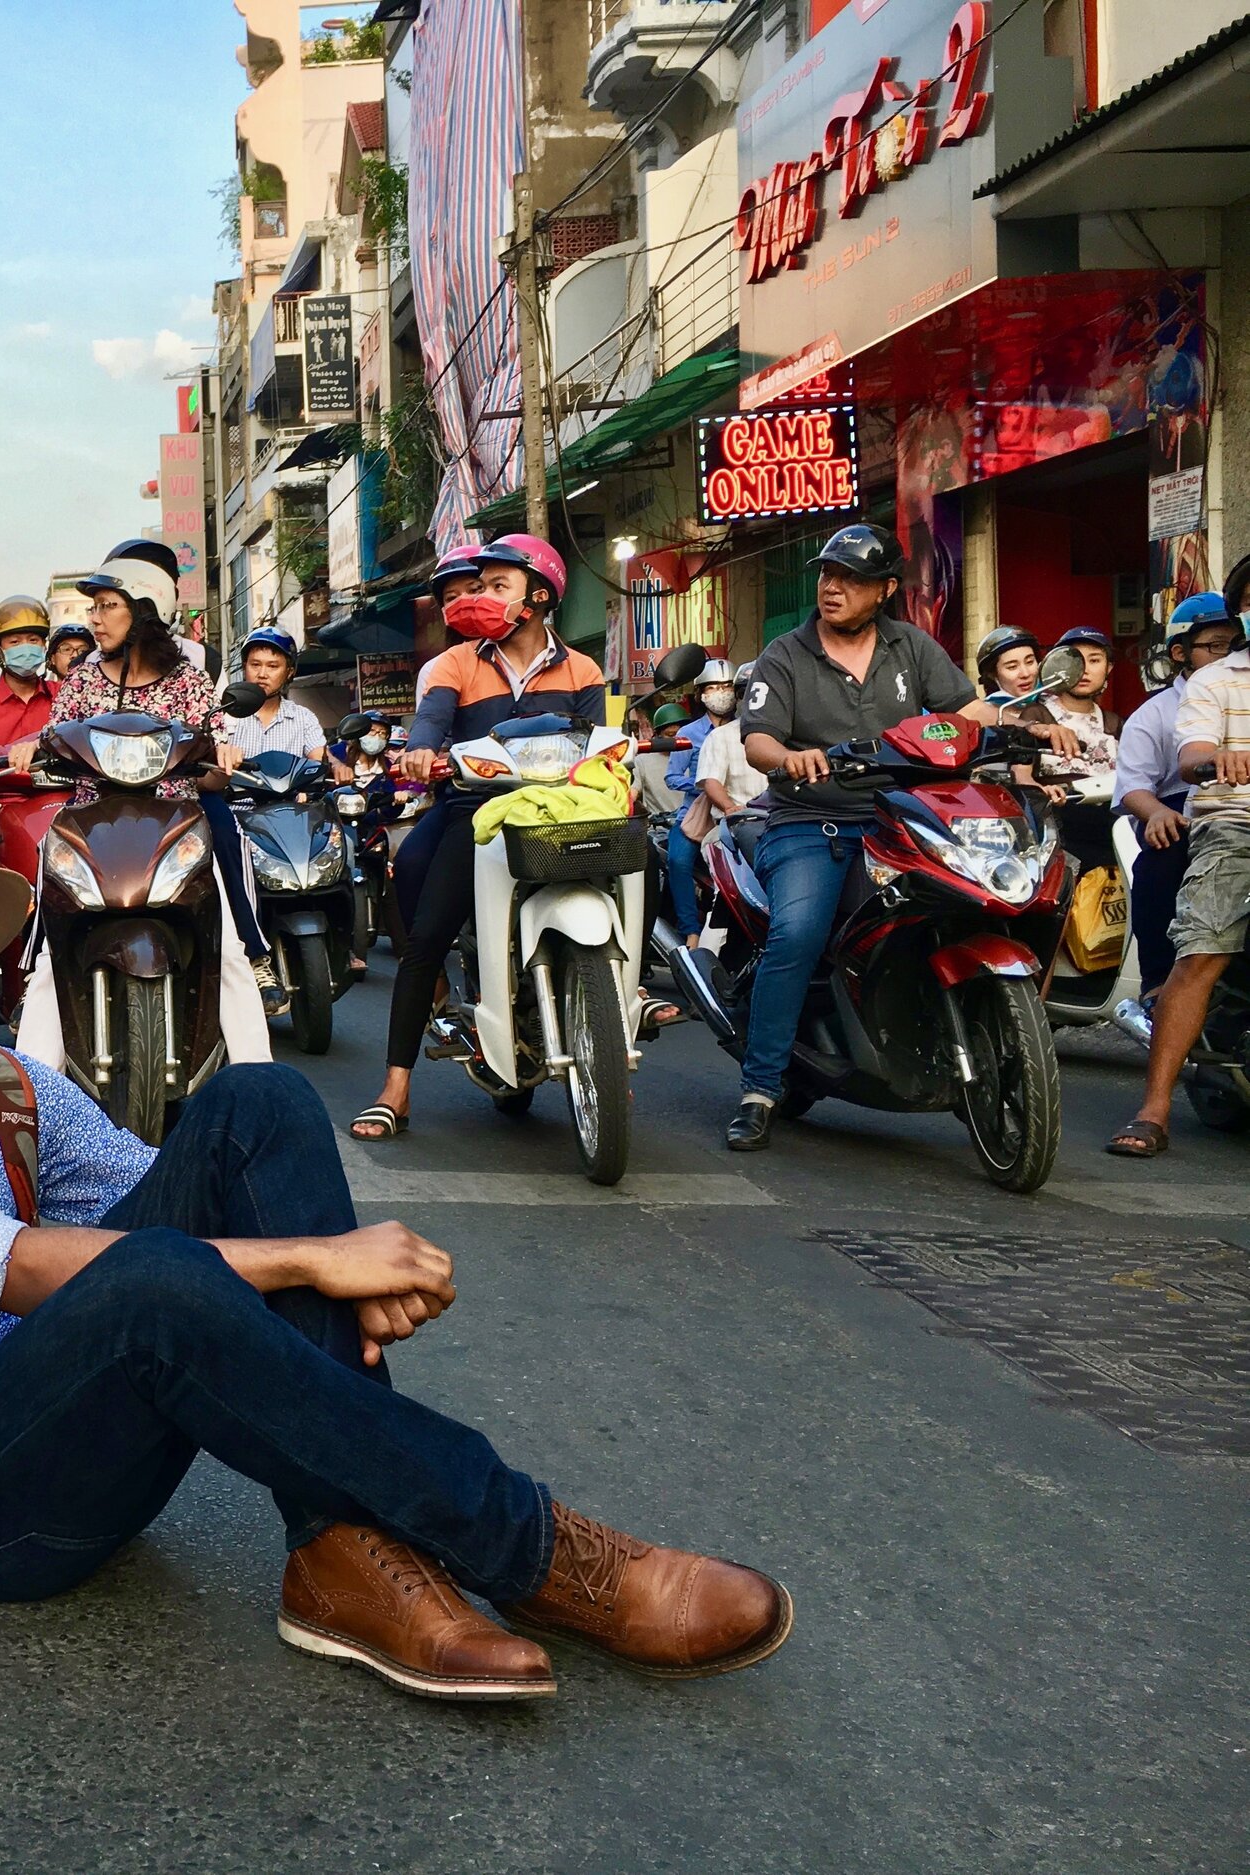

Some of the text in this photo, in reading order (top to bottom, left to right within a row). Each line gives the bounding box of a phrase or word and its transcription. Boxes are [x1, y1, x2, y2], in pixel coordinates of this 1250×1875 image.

[938, 1, 990, 148] 2
[803, 256, 837, 293] THE
[843, 225, 882, 270] SUN
[307, 302, 346, 312] Nhà May
[165, 440, 199, 461] KHU
[724, 412, 834, 465] GAME
[170, 475, 195, 497] VUI
[709, 458, 852, 514] ONLINE
[1151, 485, 1165, 495] NET
[667, 576, 725, 649] KOREA
[748, 681, 769, 710] 3
[570, 841, 601, 850] HONDA
